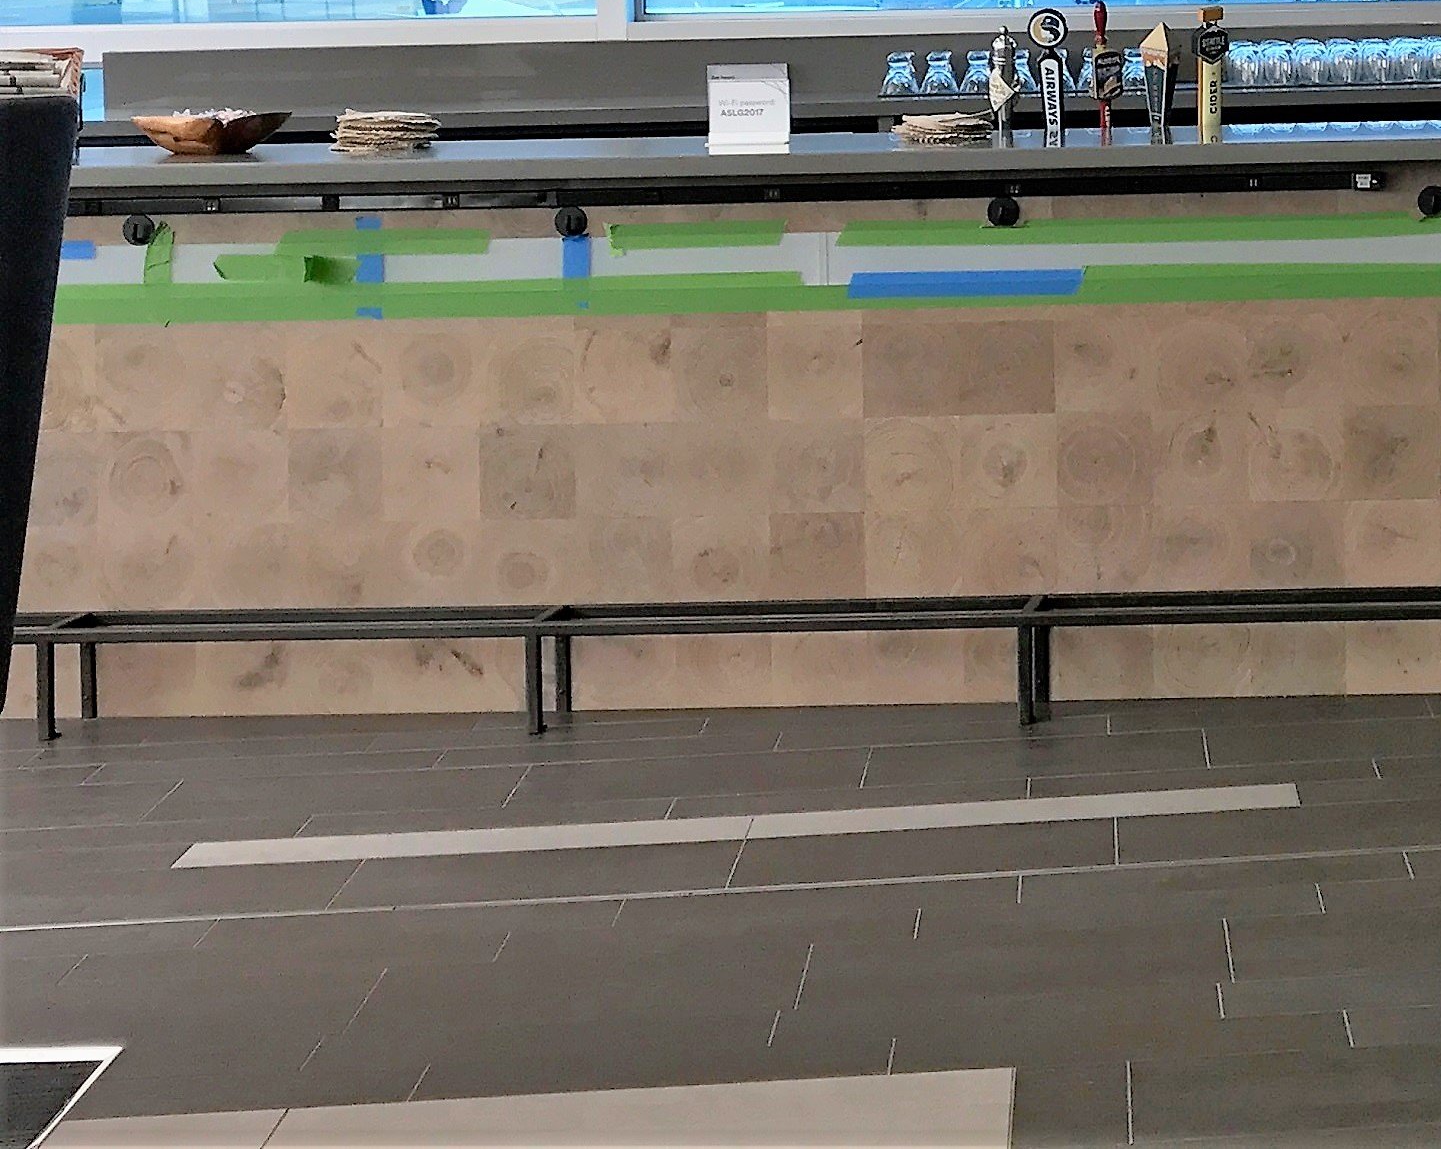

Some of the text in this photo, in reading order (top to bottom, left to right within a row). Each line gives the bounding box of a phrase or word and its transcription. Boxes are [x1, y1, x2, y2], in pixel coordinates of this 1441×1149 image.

[721, 108, 765, 117] ASLG2017
[1044, 66, 1059, 126] AIRWAYS
[1209, 80, 1218, 115] CIDER
